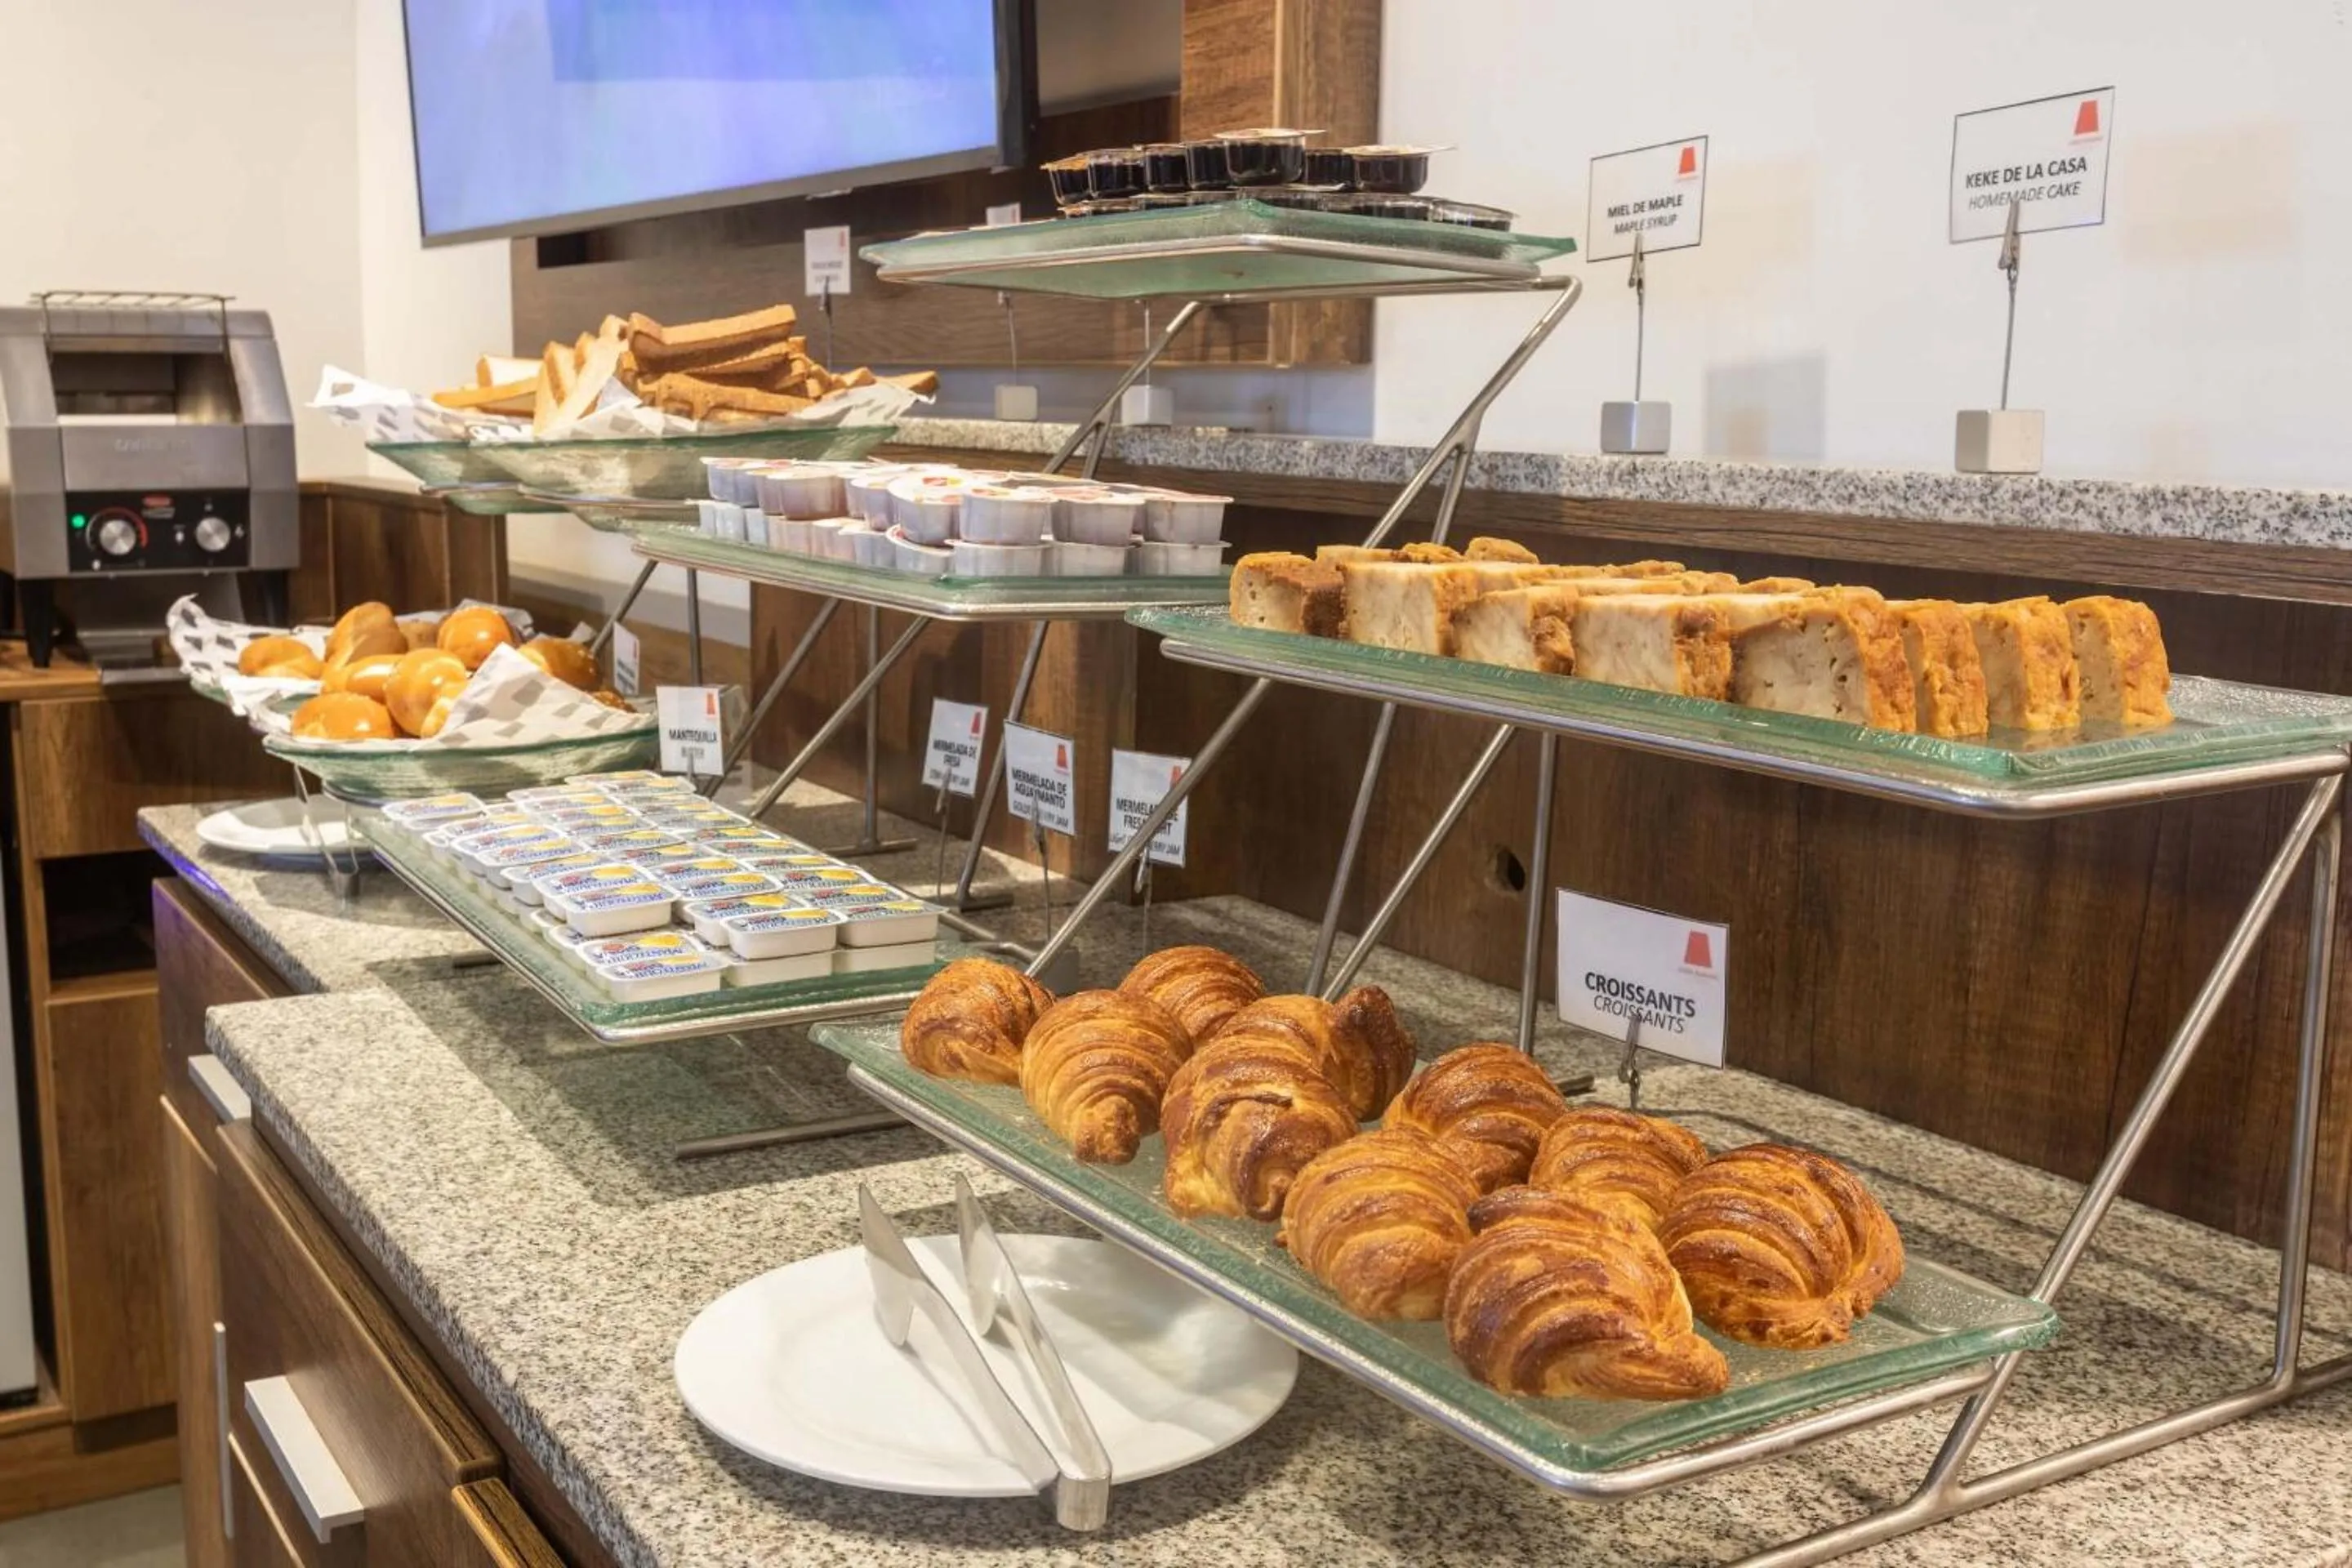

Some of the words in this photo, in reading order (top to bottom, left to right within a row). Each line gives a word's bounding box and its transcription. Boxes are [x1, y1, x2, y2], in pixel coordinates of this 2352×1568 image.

[1966, 170, 2000, 189] KEKE
[2003, 166, 2022, 183] DE
[2026, 163, 2043, 180] LA
[2047, 156, 2087, 176] CASA
[1607, 204, 1630, 218] MIEL
[1633, 201, 1646, 214] DE
[1648, 194, 1683, 210] MAPLE
[1968, 186, 2046, 210] HOMEMADE
[2047, 181, 2082, 199] CAKE
[1614, 218, 1644, 234] MAPLE
[1646, 213, 1678, 229] SYRUP
[1012, 767, 1056, 792] MERMELADA
[1057, 782, 1067, 796] DE
[1584, 972, 1696, 1018] CROISSANTS
[1593, 995, 1686, 1034] CROISSANTS
